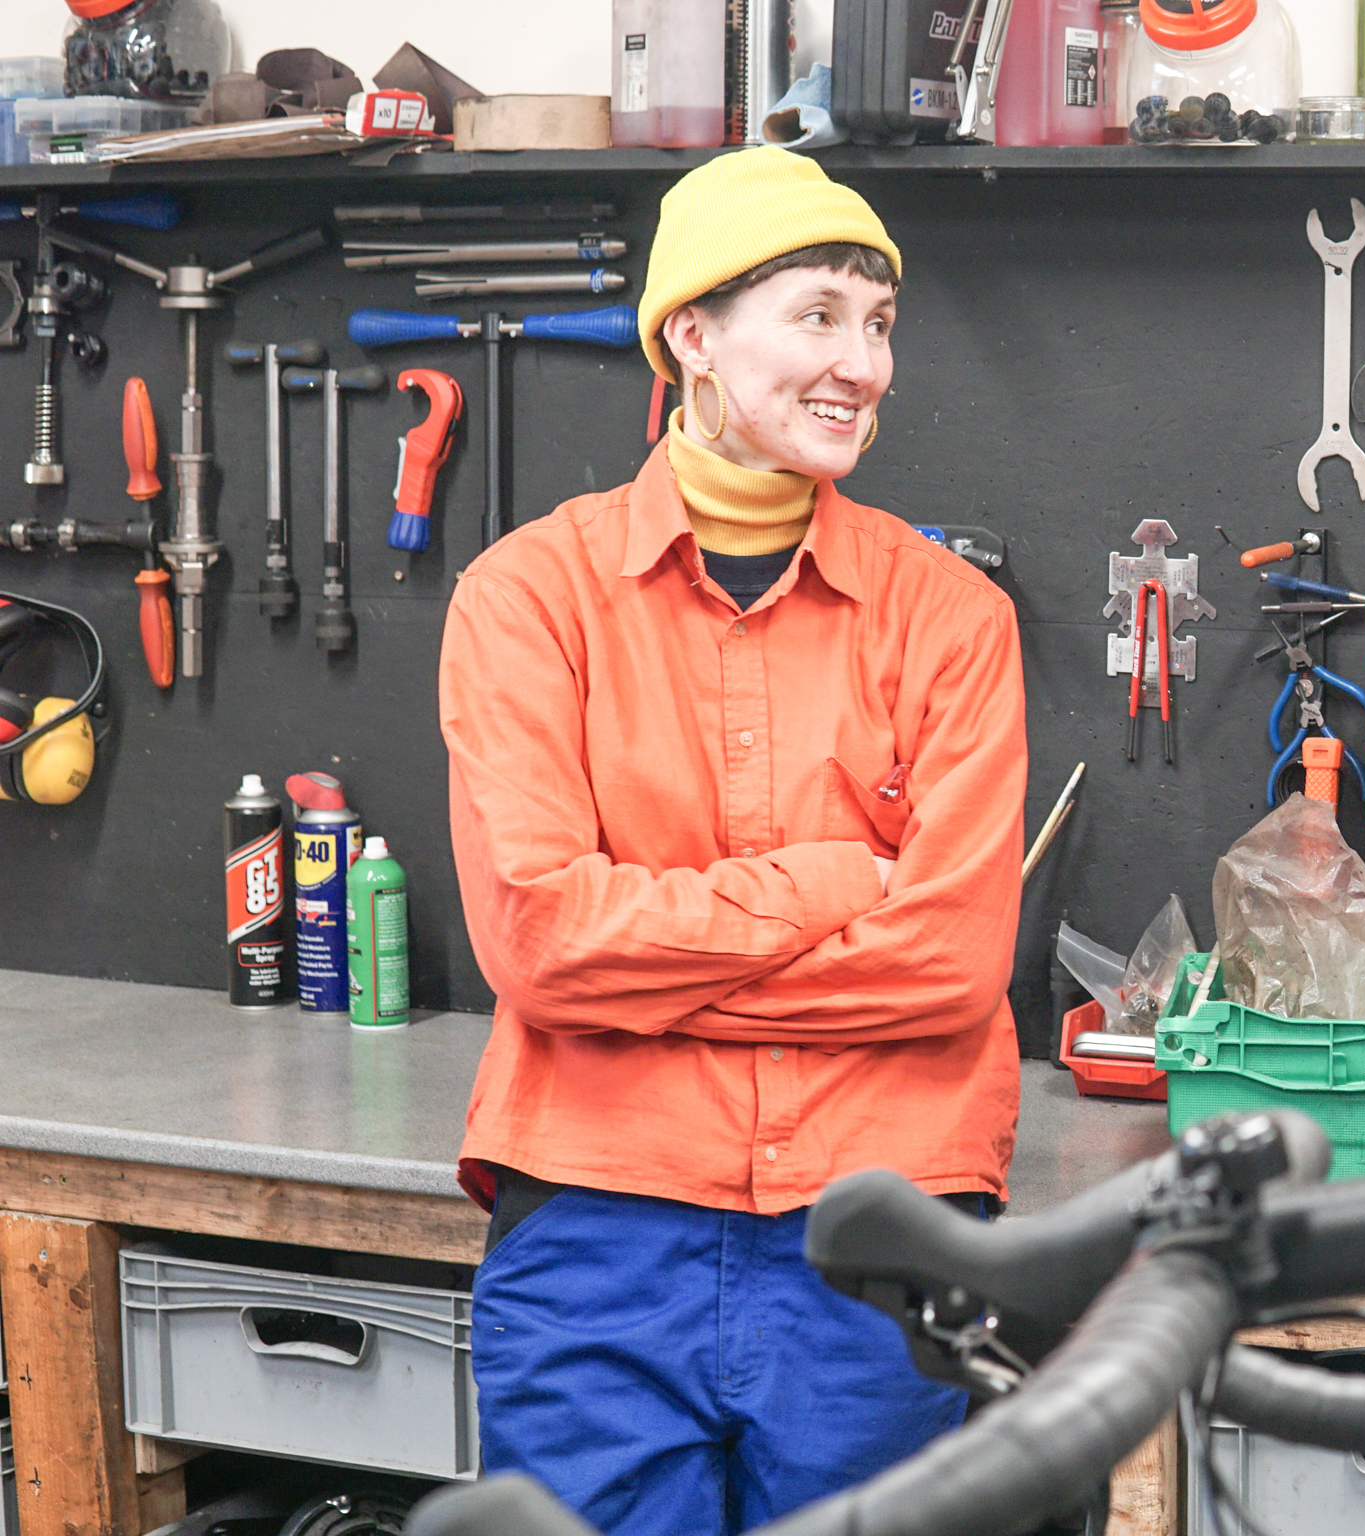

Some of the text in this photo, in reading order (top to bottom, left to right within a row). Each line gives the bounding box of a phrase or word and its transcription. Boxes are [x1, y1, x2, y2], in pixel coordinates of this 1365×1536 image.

[377, 108, 392, 119] x10
[294, 838, 329, 862] D-40
[246, 846, 279, 886] GT
[246, 874, 280, 914] 85
[255, 953, 276, 963] Spray
